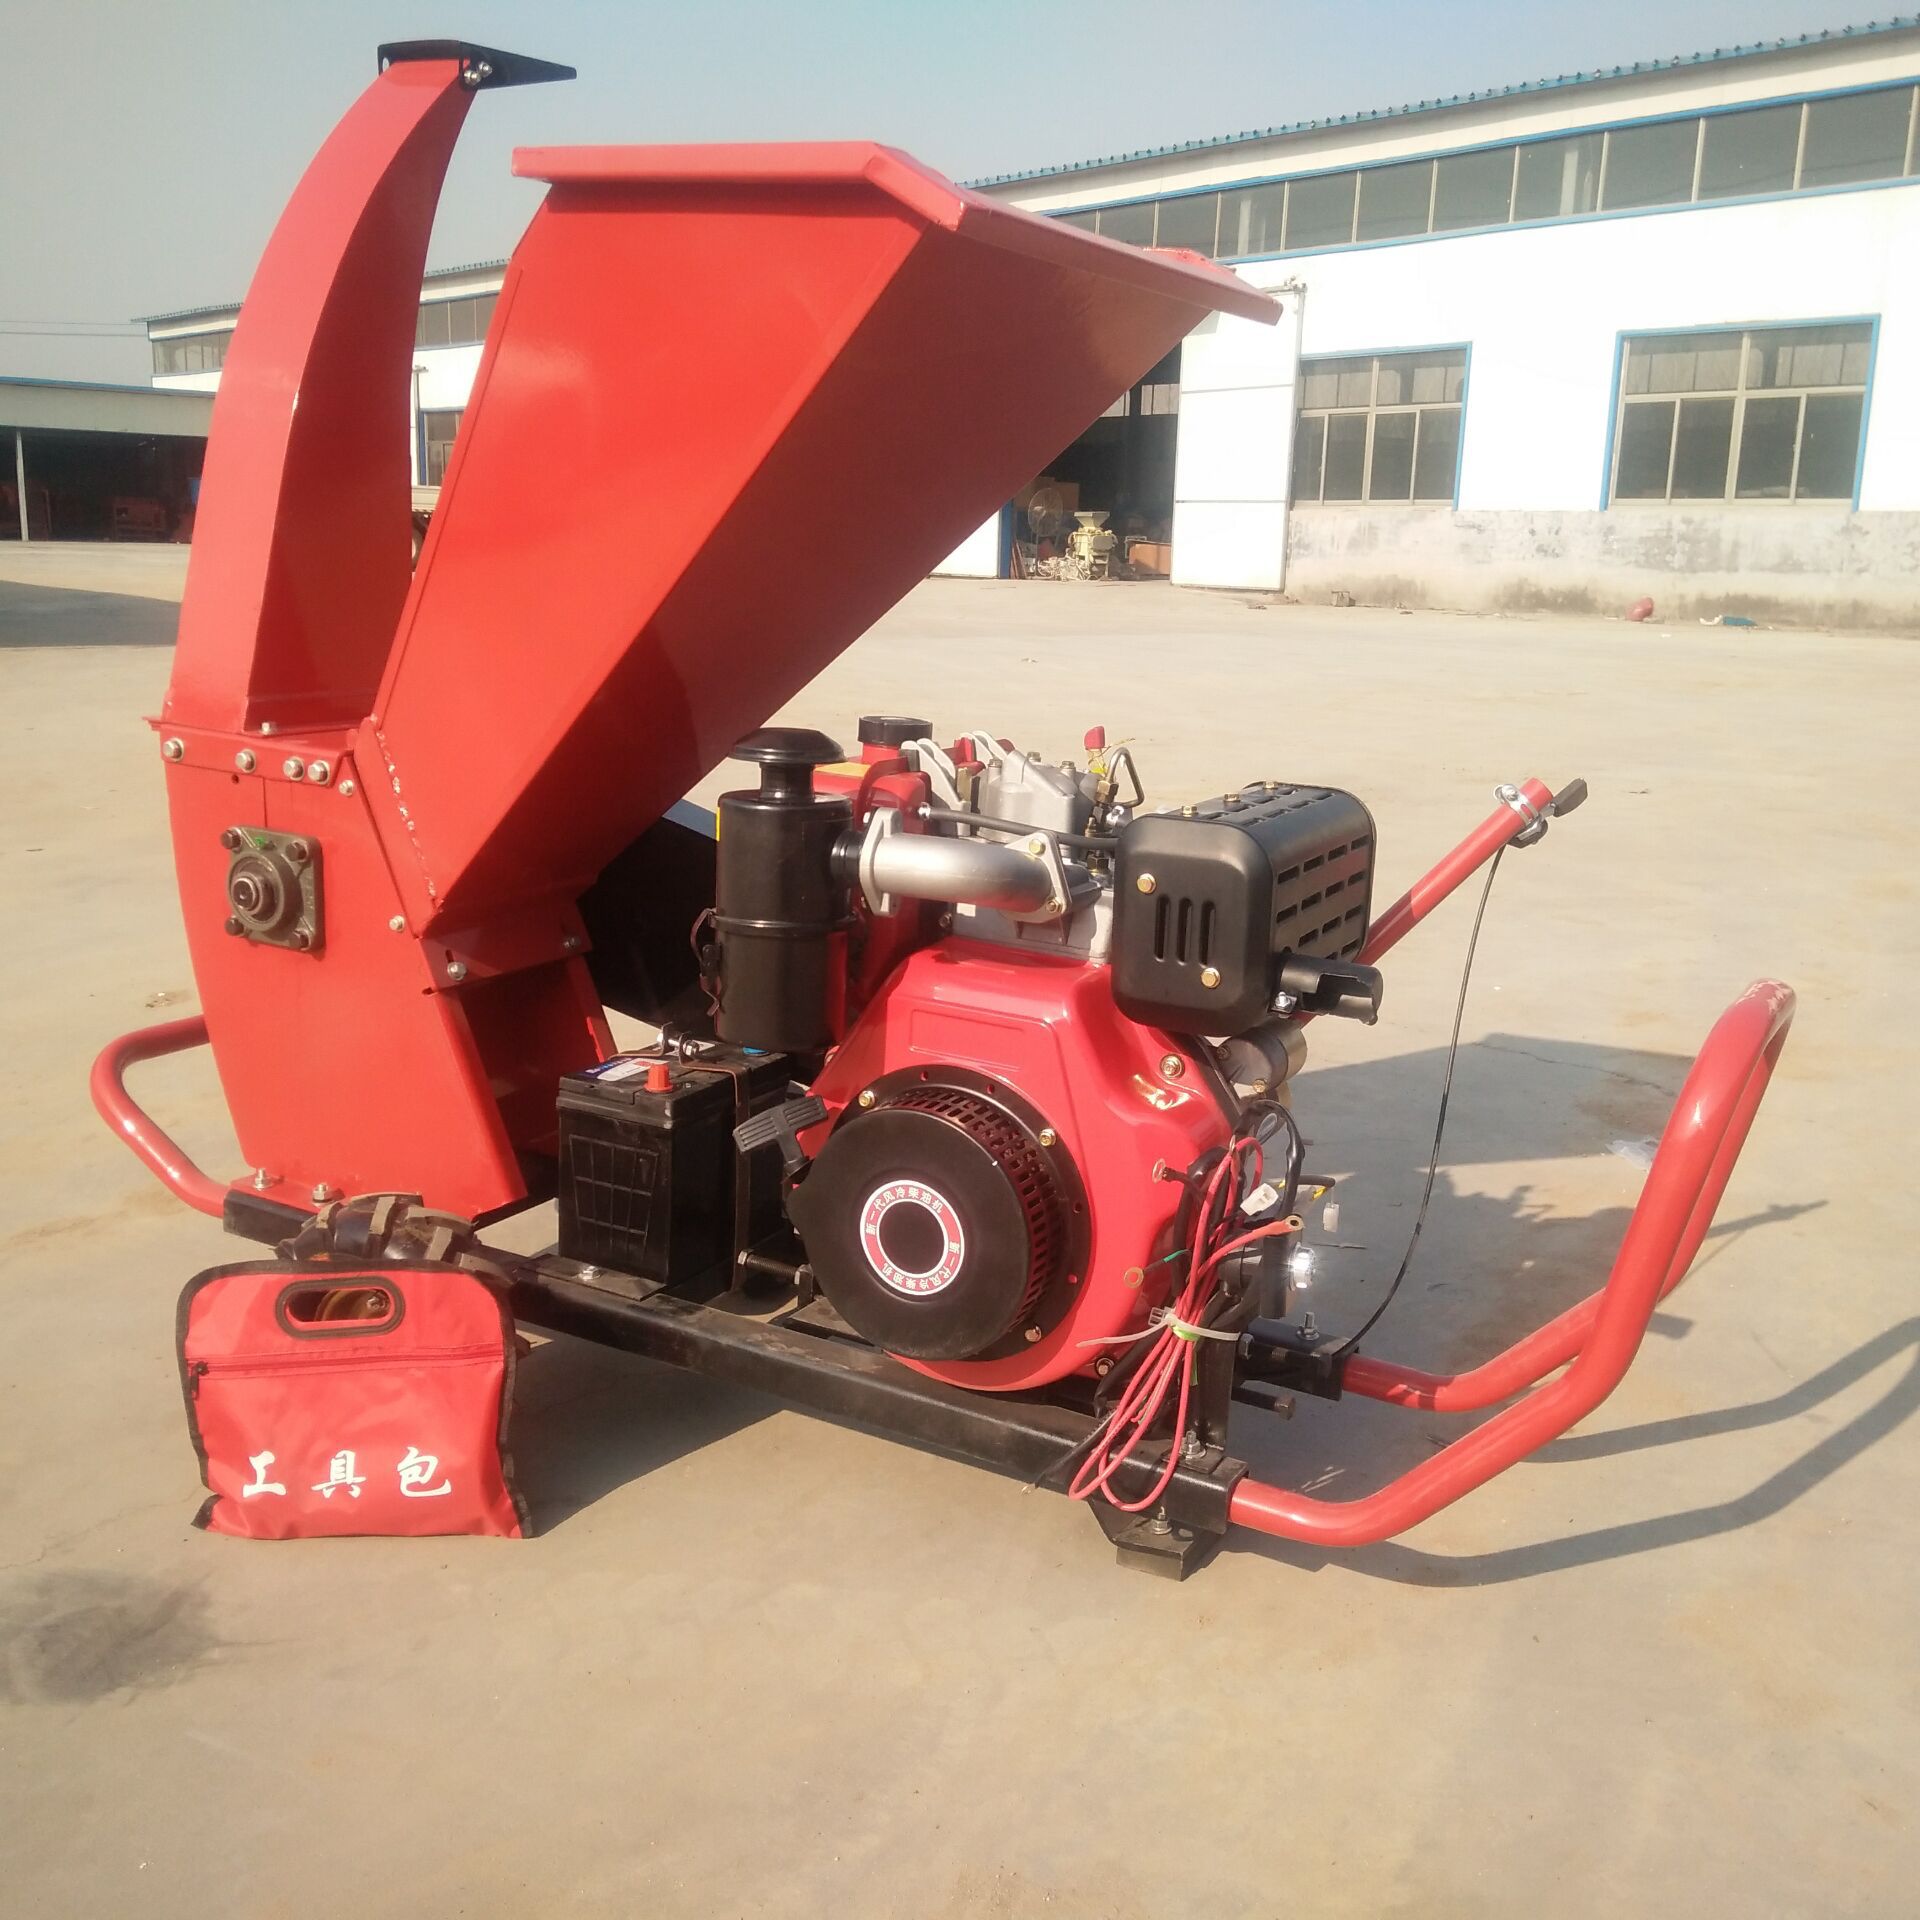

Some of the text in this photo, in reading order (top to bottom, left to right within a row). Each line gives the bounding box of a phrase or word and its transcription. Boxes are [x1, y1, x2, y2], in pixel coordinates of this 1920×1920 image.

[865, 1186, 943, 1236] 新一代风冷柴油机
[242, 1447, 452, 1498] 工具包
